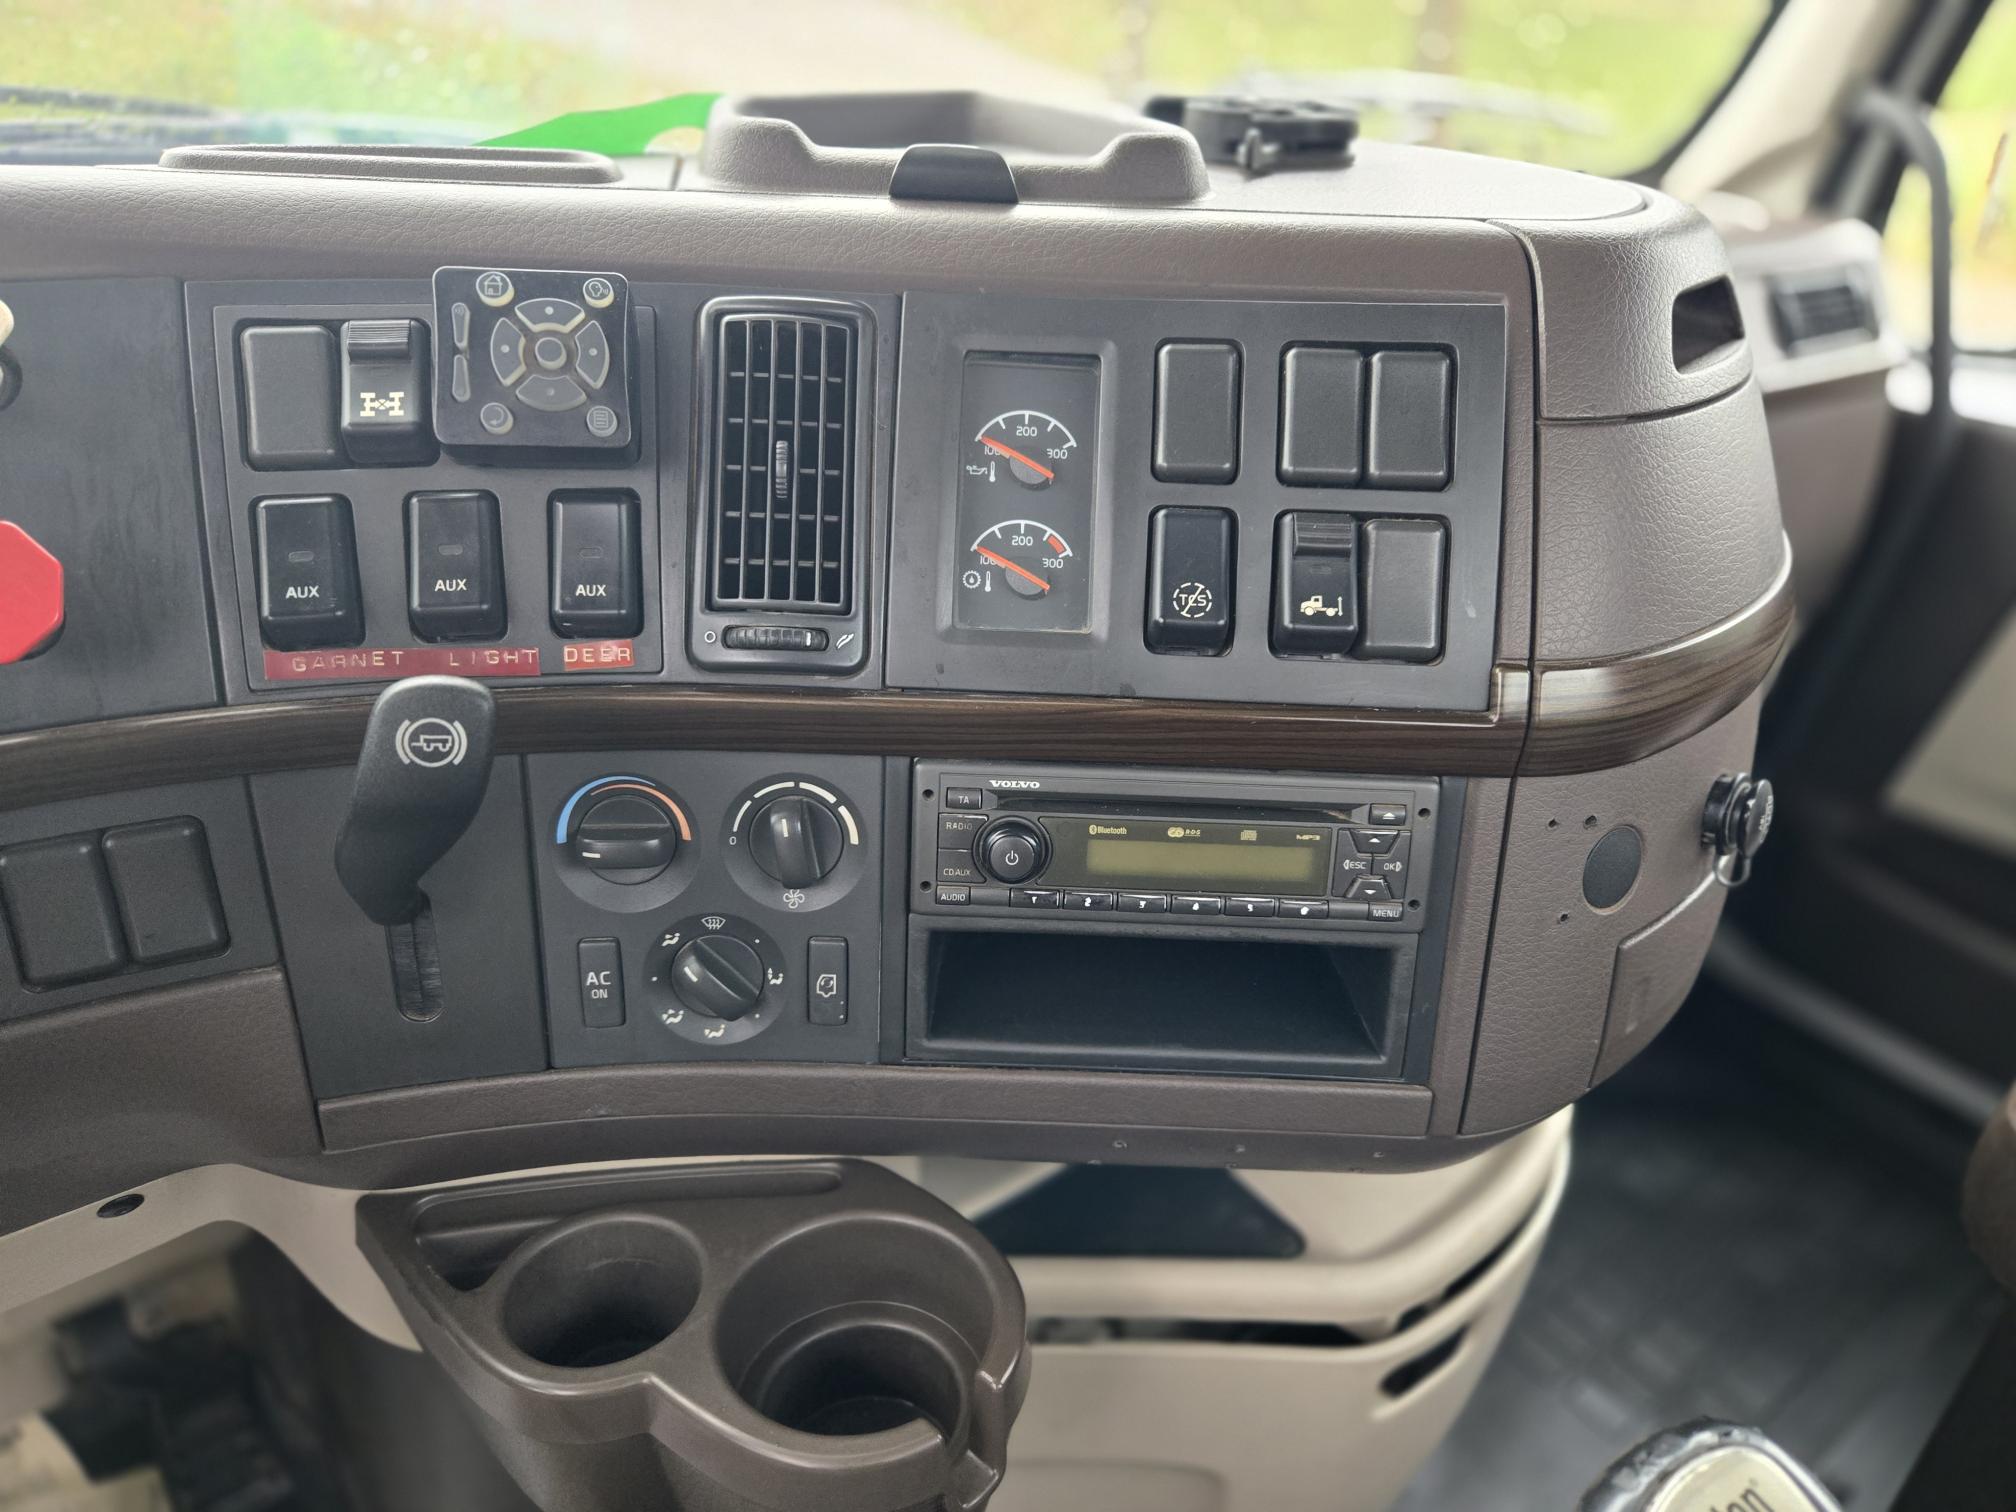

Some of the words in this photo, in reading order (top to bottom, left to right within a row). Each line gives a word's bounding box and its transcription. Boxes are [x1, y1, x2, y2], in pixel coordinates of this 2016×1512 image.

[1016, 426, 1037, 437] 200
[1046, 448, 1068, 459] 300
[1011, 535, 1033, 546] 200
[1042, 557, 1064, 568] 300
[434, 578, 467, 592] AUX
[575, 584, 607, 597] AUX
[285, 585, 320, 599] AUX
[1179, 593, 1207, 607] TCS
[292, 650, 404, 672] GARNET
[449, 647, 538, 667] LIGHT
[564, 645, 632, 663] DEER
[988, 780, 1040, 789] VOLVO
[958, 795, 970, 804] TA
[945, 822, 972, 831] RADIO
[1097, 826, 1127, 835] Bluetooth
[1349, 861, 1367, 869] ESC
[1383, 862, 1396, 871] OK
[955, 868, 971, 876] AUX
[940, 893, 966, 902] AUDIO
[1372, 909, 1400, 918] MENU
[586, 971, 611, 986] AC
[591, 988, 608, 999] ON
